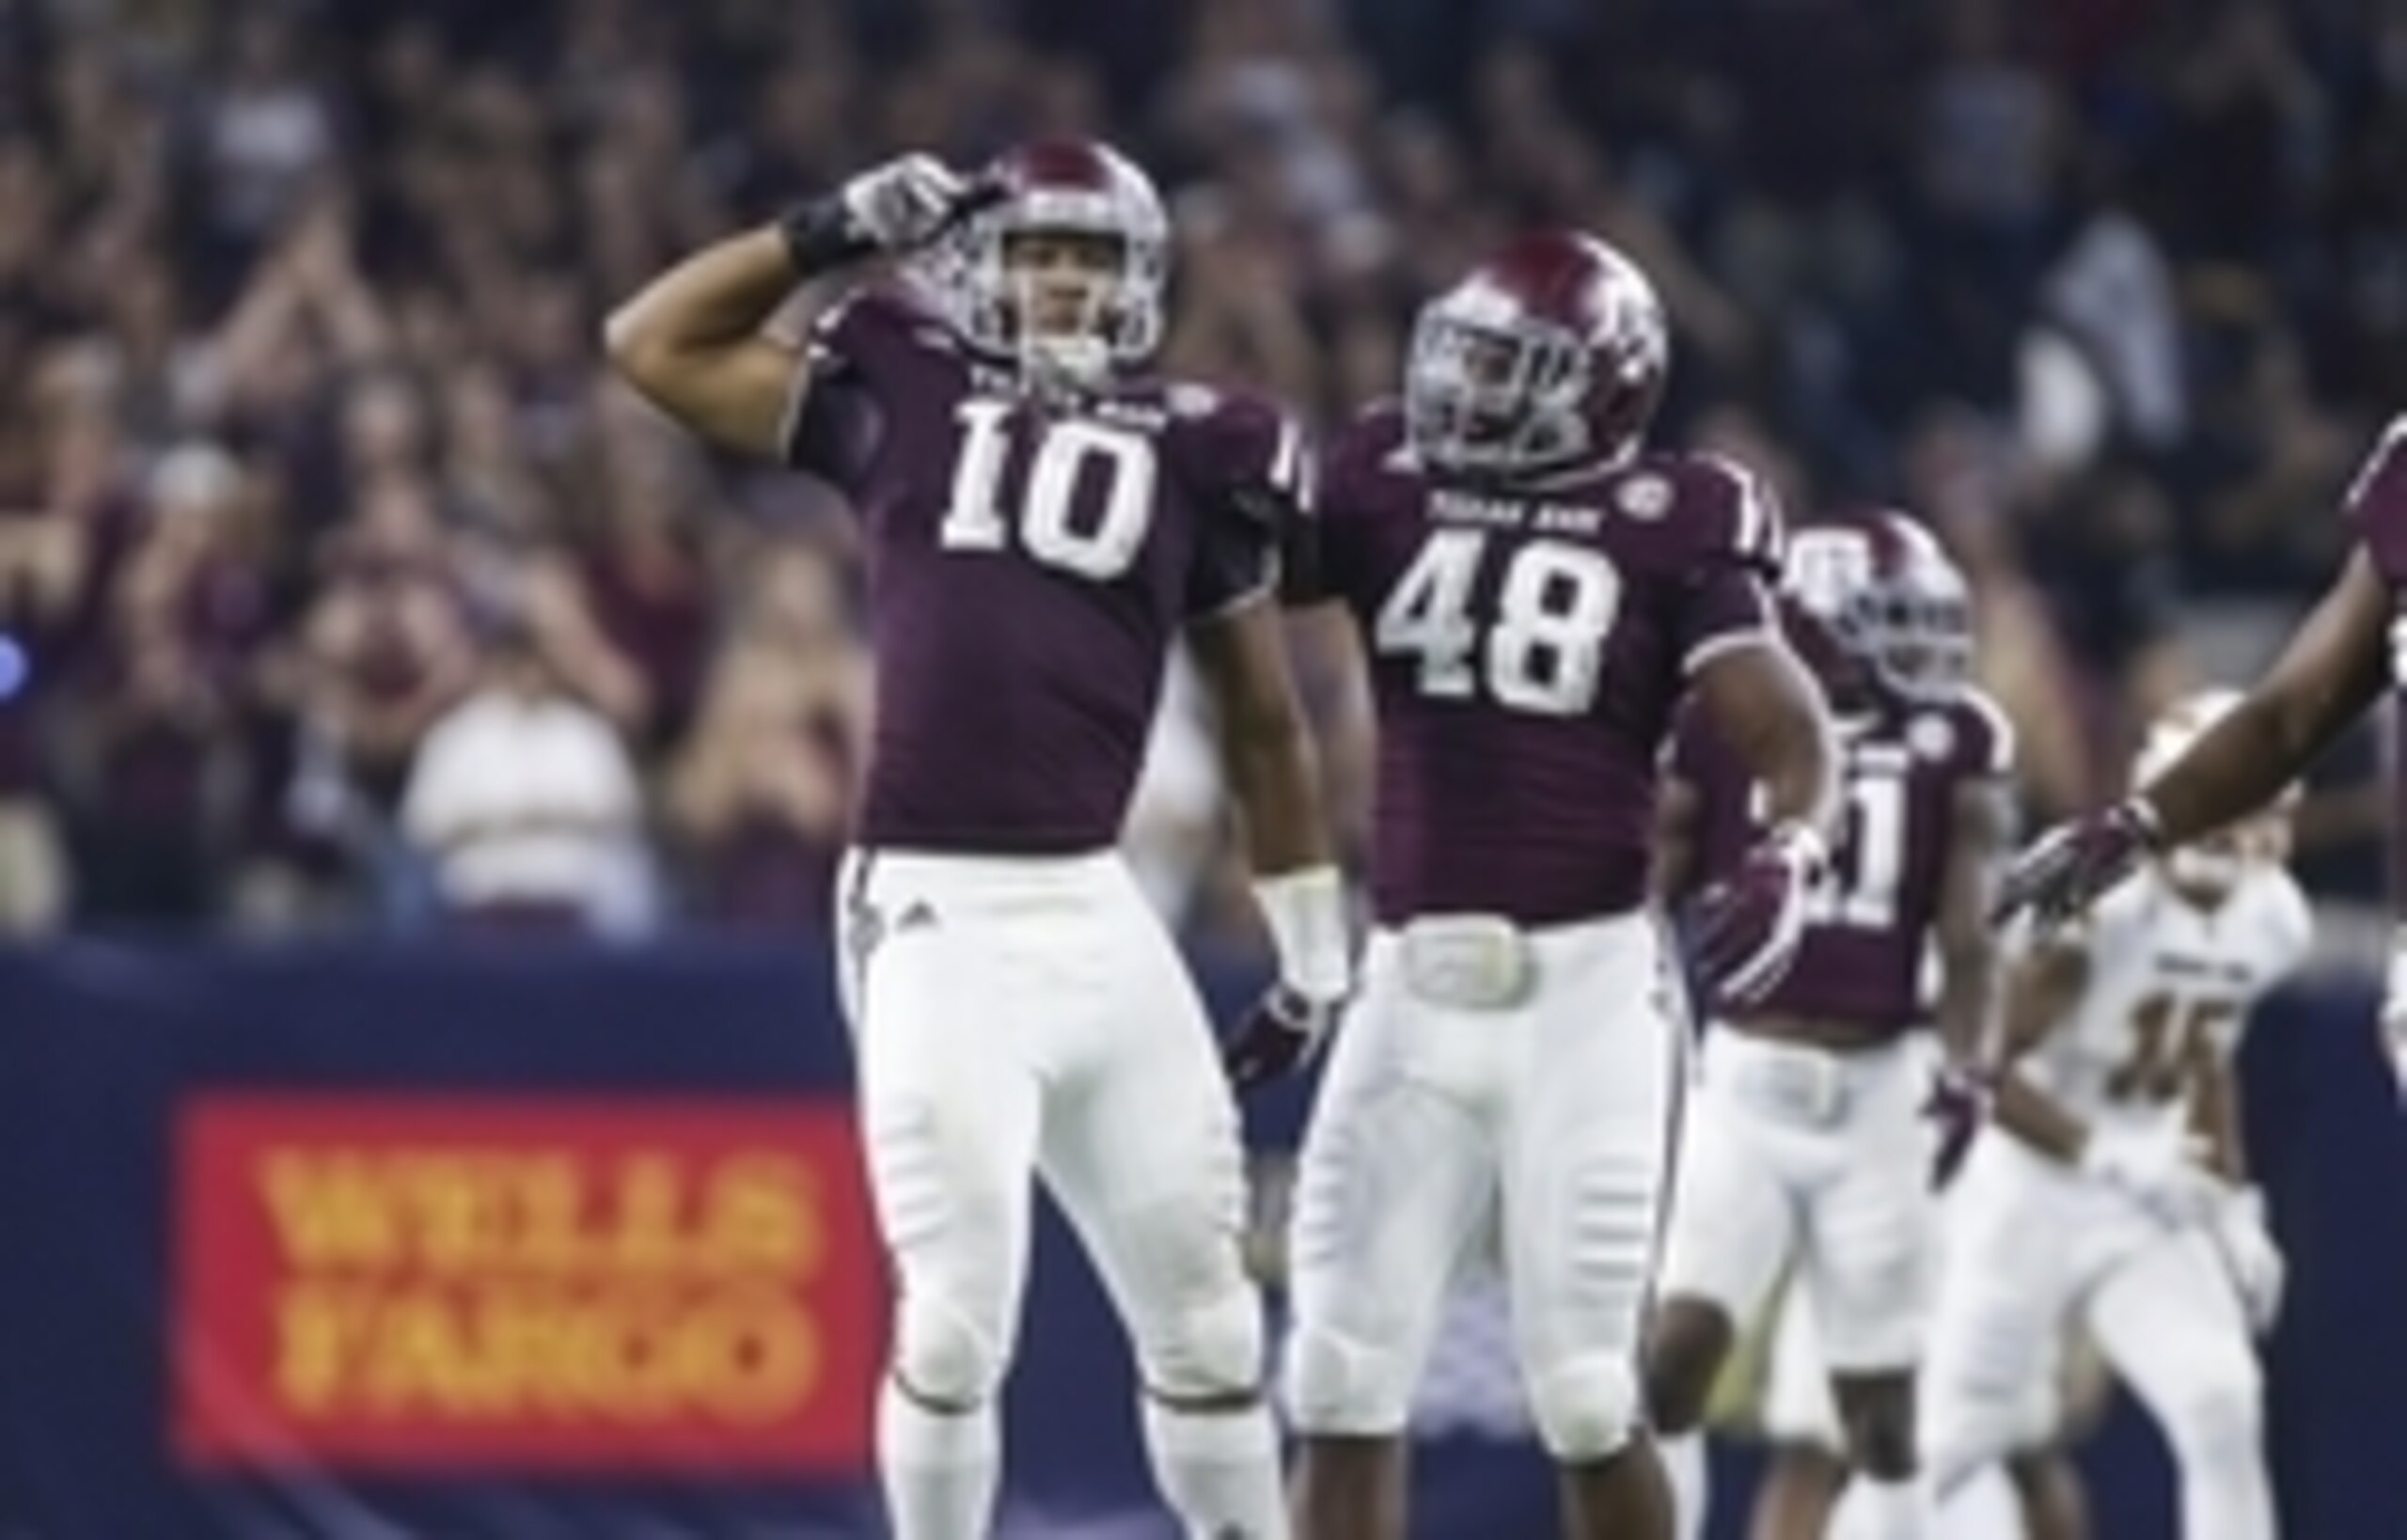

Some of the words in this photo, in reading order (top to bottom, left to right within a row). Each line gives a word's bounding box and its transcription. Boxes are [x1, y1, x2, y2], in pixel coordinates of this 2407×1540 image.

[940, 399, 1156, 581] 10
[1375, 526, 1621, 716] 48
[256, 1147, 820, 1269] WELLS
[278, 1282, 818, 1420] FARGO
